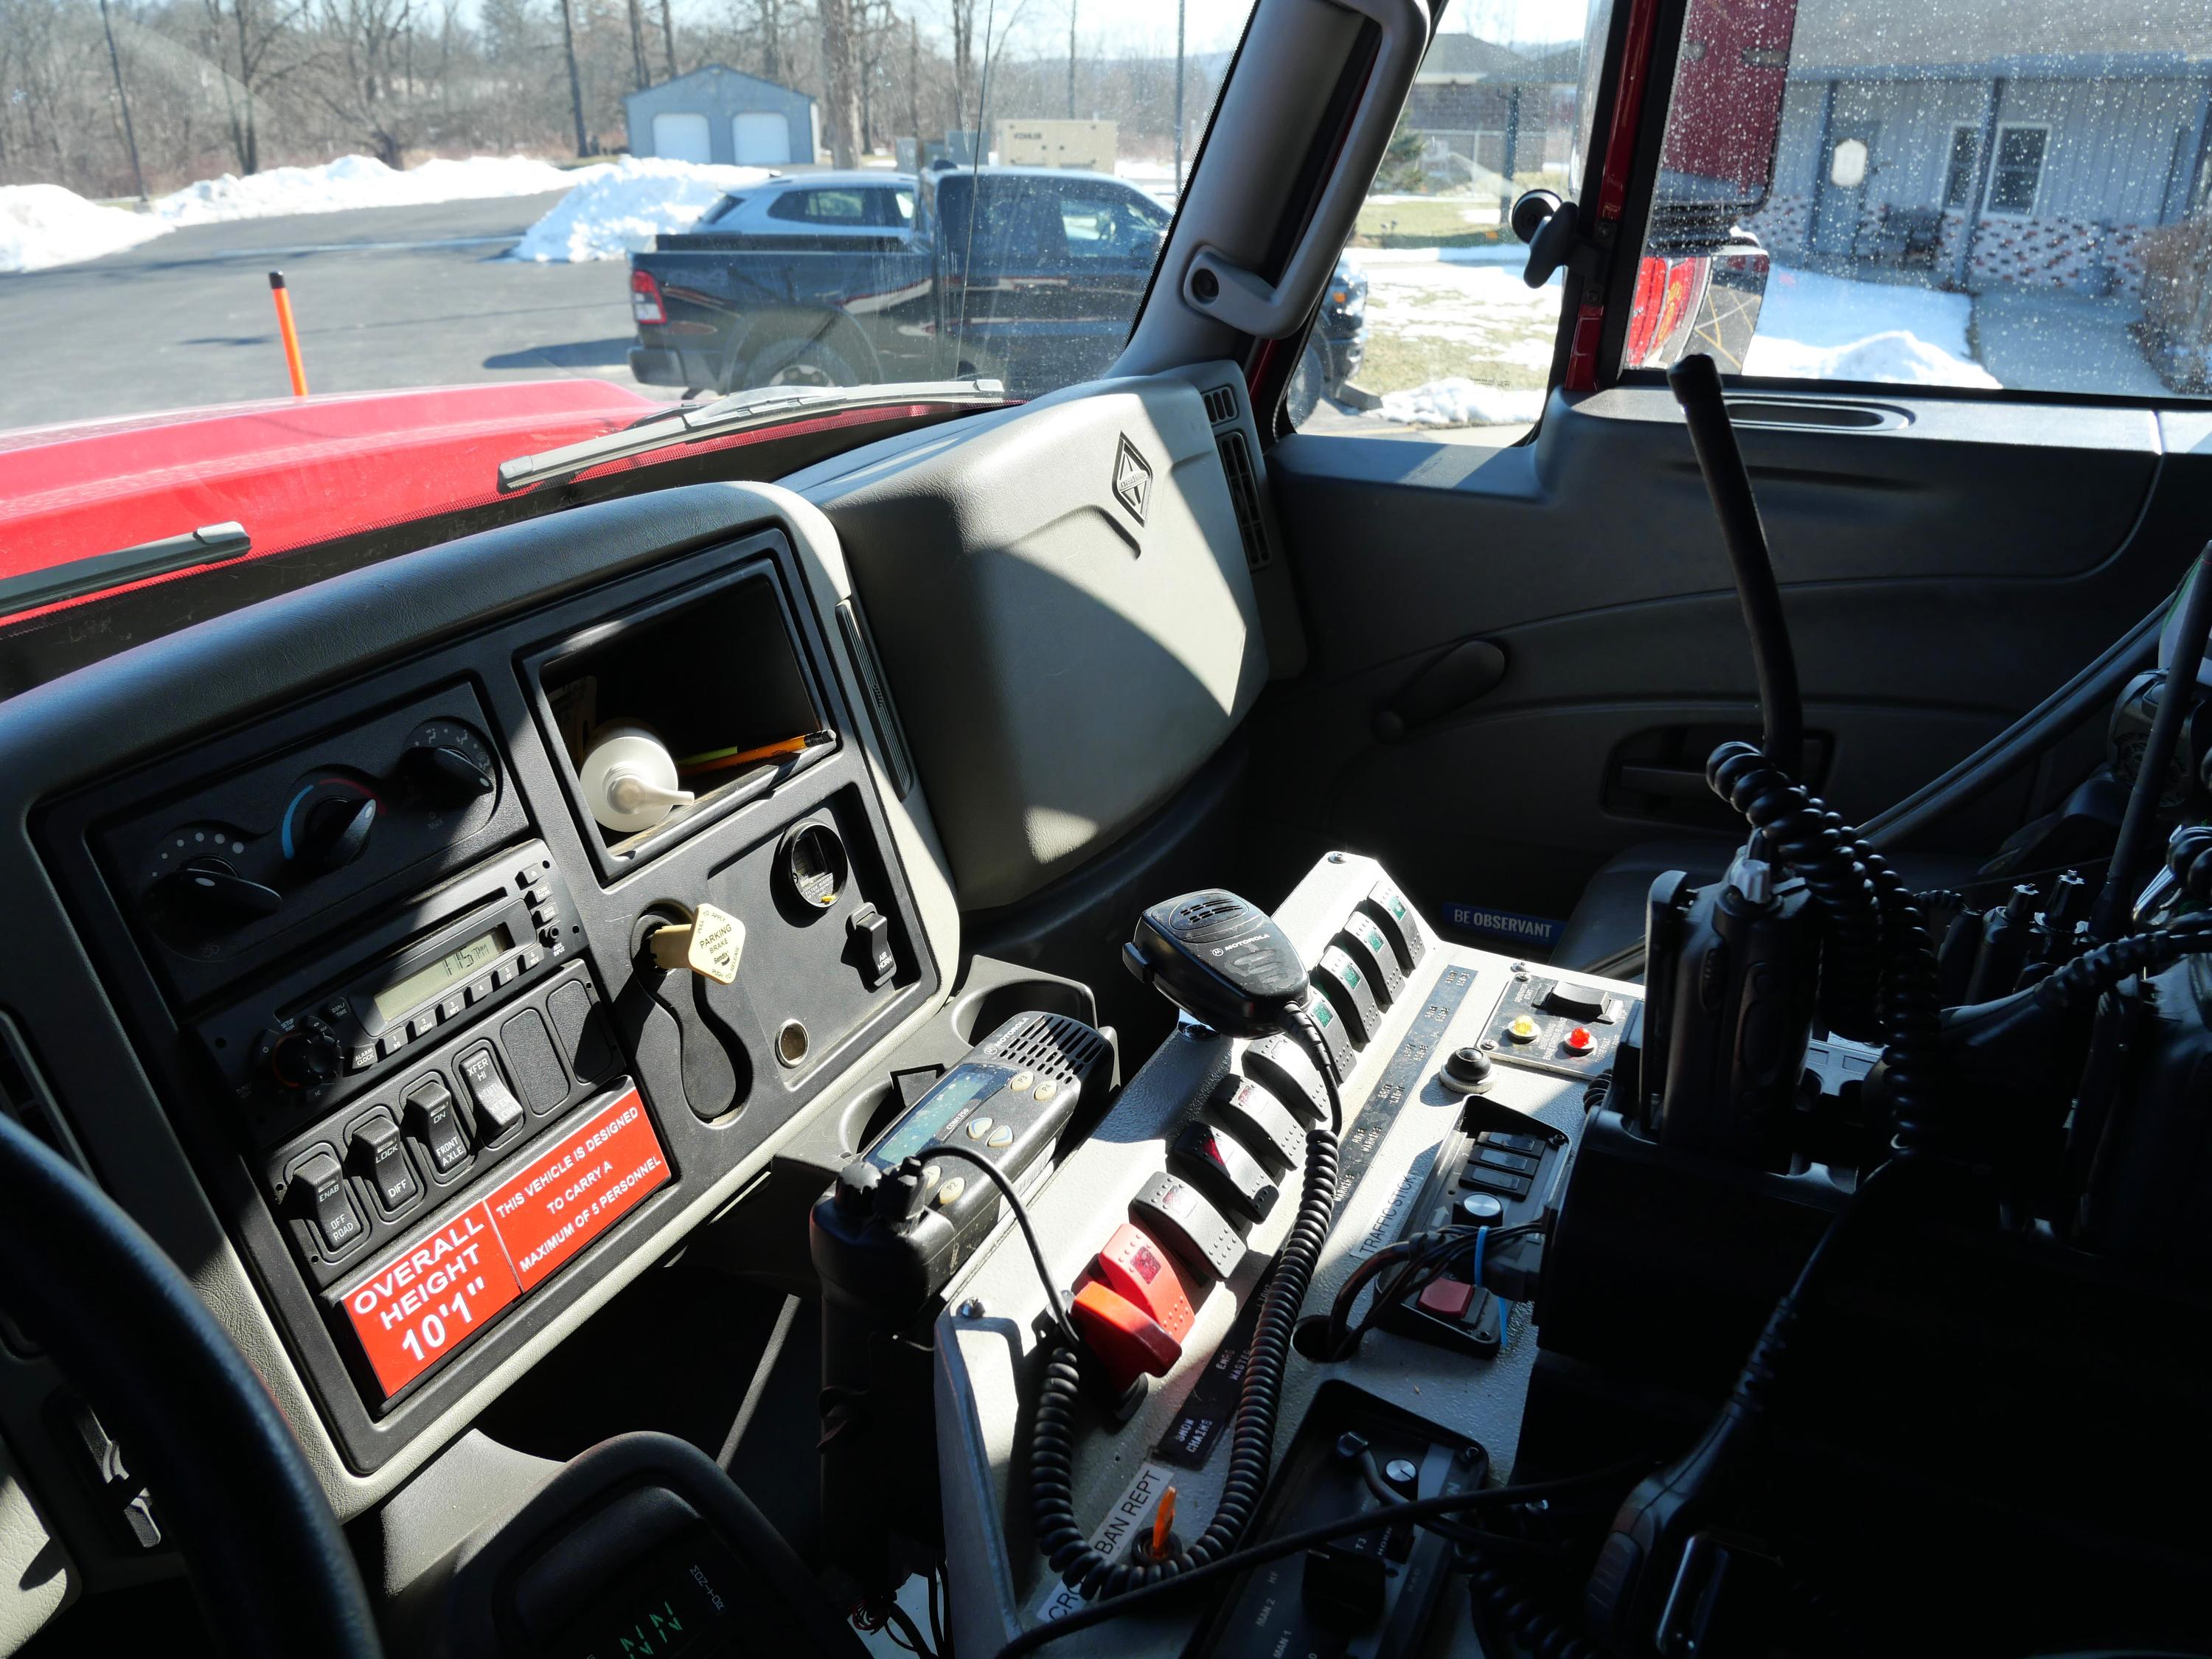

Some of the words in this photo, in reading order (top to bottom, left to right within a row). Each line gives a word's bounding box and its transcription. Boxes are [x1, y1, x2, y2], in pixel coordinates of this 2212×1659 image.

[711, 912, 726, 923] APPLY
[1454, 908, 1470, 924] BE
[1473, 912, 1552, 938] OBSERVANT
[700, 924, 732, 949] PARKING
[709, 938, 728, 953] BRAKE
[1225, 933, 1270, 951] MOTOROLA
[530, 956, 540, 966] REV
[554, 946, 566, 957] INPUT
[731, 947, 740, 972] RELEASE
[879, 951, 888, 962] AIR
[877, 956, 892, 971] HORN
[450, 1006, 459, 1015] RPT
[280, 1018, 294, 1029] SETUP
[420, 1022, 433, 1033] RDM
[995, 1017, 1029, 1048] MOTOROLA
[355, 1048, 373, 1062] ALARM
[357, 1054, 375, 1066] CLOCK
[467, 1058, 489, 1077] XFER
[477, 1071, 487, 1081] HI
[1018, 1075, 1027, 1083] P3
[1042, 1084, 1051, 1092] P4
[434, 1112, 447, 1124] ON
[946, 1107, 970, 1130] CDM1250
[437, 1136, 459, 1157] FRONT
[1361, 1126, 1382, 1152] WARNING
[375, 1144, 399, 1164] LOCK
[442, 1147, 464, 1166] AXLE
[495, 1192, 526, 1218] THIS
[524, 1155, 574, 1197] VEHICLE
[574, 1147, 585, 1162] IS
[585, 1107, 639, 1152] DESIGNED
[319, 1184, 340, 1203] ENAB
[388, 1179, 408, 1198] DIFF
[546, 1197, 564, 1214] TO
[565, 1166, 602, 1202] CARRY
[603, 1161, 613, 1174] A
[947, 1182, 958, 1191] P2
[1333, 1174, 1355, 1202] WARNING
[330, 1214, 345, 1230] OFF
[519, 1222, 575, 1273] MAXIMUM
[575, 1208, 591, 1228] OF
[591, 1203, 599, 1215] 5
[599, 1155, 662, 1209] PERSONNEL
[1359, 1206, 1397, 1254] TRAFFIC
[1392, 1174, 1417, 1212] STICK
[333, 1222, 354, 1241] ROAD
[355, 1217, 485, 1314] OVERALL
[380, 1243, 479, 1330] HEIGHT
[402, 1276, 485, 1361] 10'1"
[1175, 1418, 1195, 1442] SNOW
[1186, 1419, 1214, 1453] CHAINS
[1094, 1517, 1130, 1554] BAN
[1121, 1470, 1161, 1516] REPT
[690, 1565, 726, 1611] MONITOR
[1256, 1607, 1270, 1627] MAN
[1266, 1598, 1276, 1607] 2
[1273, 1636, 1289, 1659] MAN
